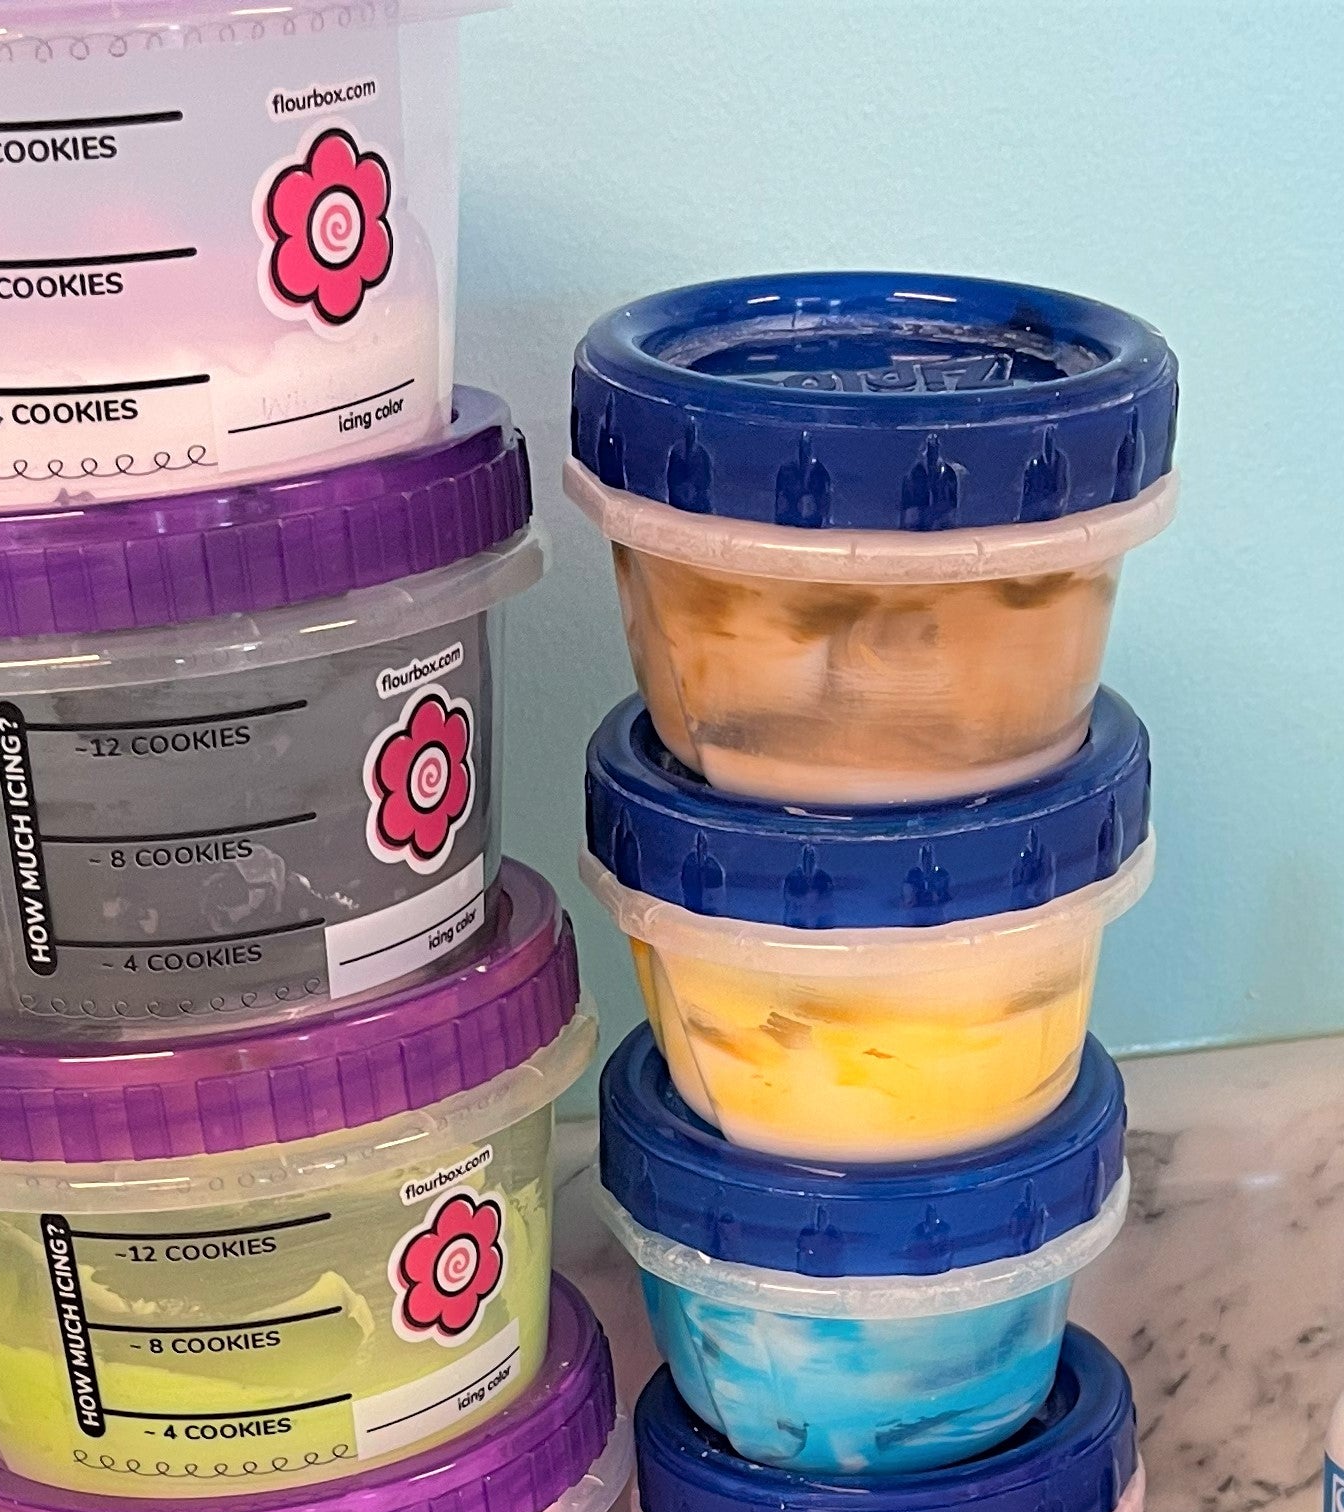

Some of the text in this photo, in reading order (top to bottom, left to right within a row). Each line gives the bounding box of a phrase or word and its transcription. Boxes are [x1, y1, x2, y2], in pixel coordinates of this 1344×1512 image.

[272, 77, 377, 115] flourbox.com
[10, 398, 138, 426] COOKIES
[338, 397, 405, 433] icing color
[382, 647, 462, 692] flourbox.com
[131, 726, 252, 756] COOKIES
[11, 814, 41, 891] MUCH
[110, 849, 126, 869] 8
[134, 839, 254, 868] COOKIES
[23, 896, 51, 963] HOW
[123, 953, 139, 974] 4
[146, 945, 263, 972] COOKIES
[405, 1147, 492, 1201] flourbox.com
[165, 1236, 277, 1262] COOKIES
[46, 1223, 100, 1427] HOW MUCH ICING?
[149, 1337, 164, 1355] 8
[171, 1329, 281, 1355] COOKIES
[162, 1424, 178, 1442] 4
[184, 1417, 292, 1441] COOKIES
